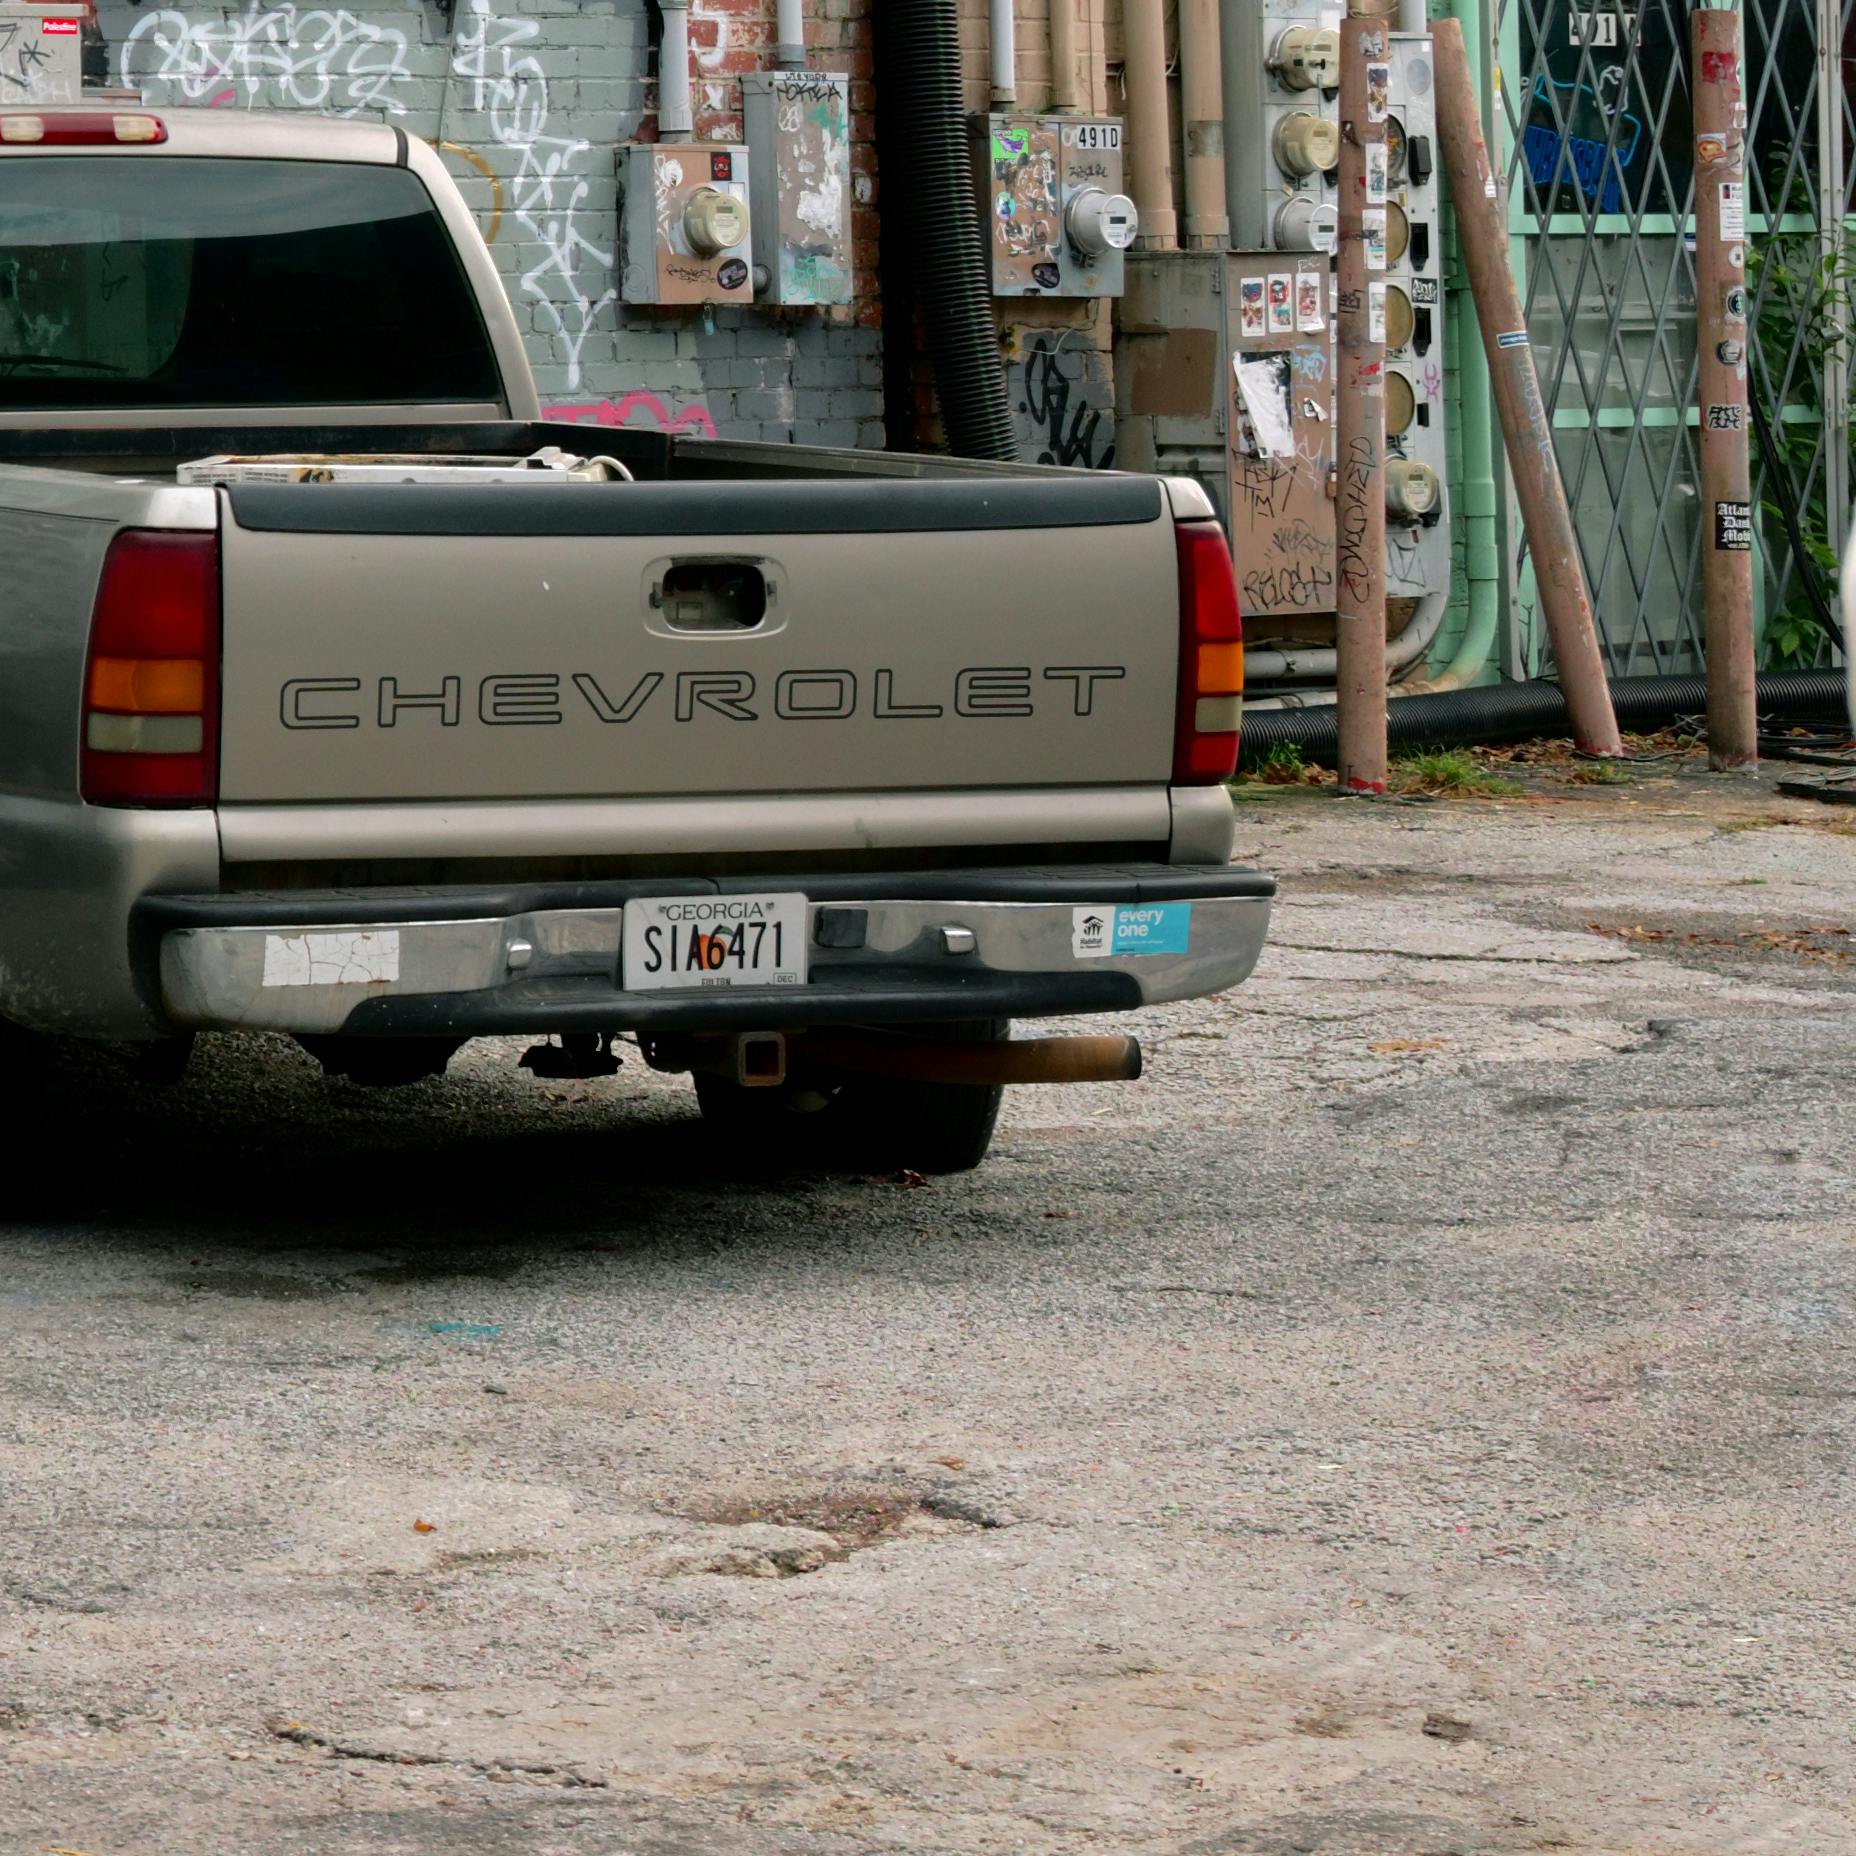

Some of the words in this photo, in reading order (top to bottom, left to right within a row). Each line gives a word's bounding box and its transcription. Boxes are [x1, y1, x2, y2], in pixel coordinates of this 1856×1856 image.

[43, 21, 78, 33] Palestine
[279, 665, 1127, 730] CHEVROLET
[666, 902, 764, 921] GEORGIA
[1119, 910, 1164, 926] every
[1117, 924, 1149, 937] one
[644, 921, 782, 973] SIA6471
[777, 975, 793, 984] DEC
